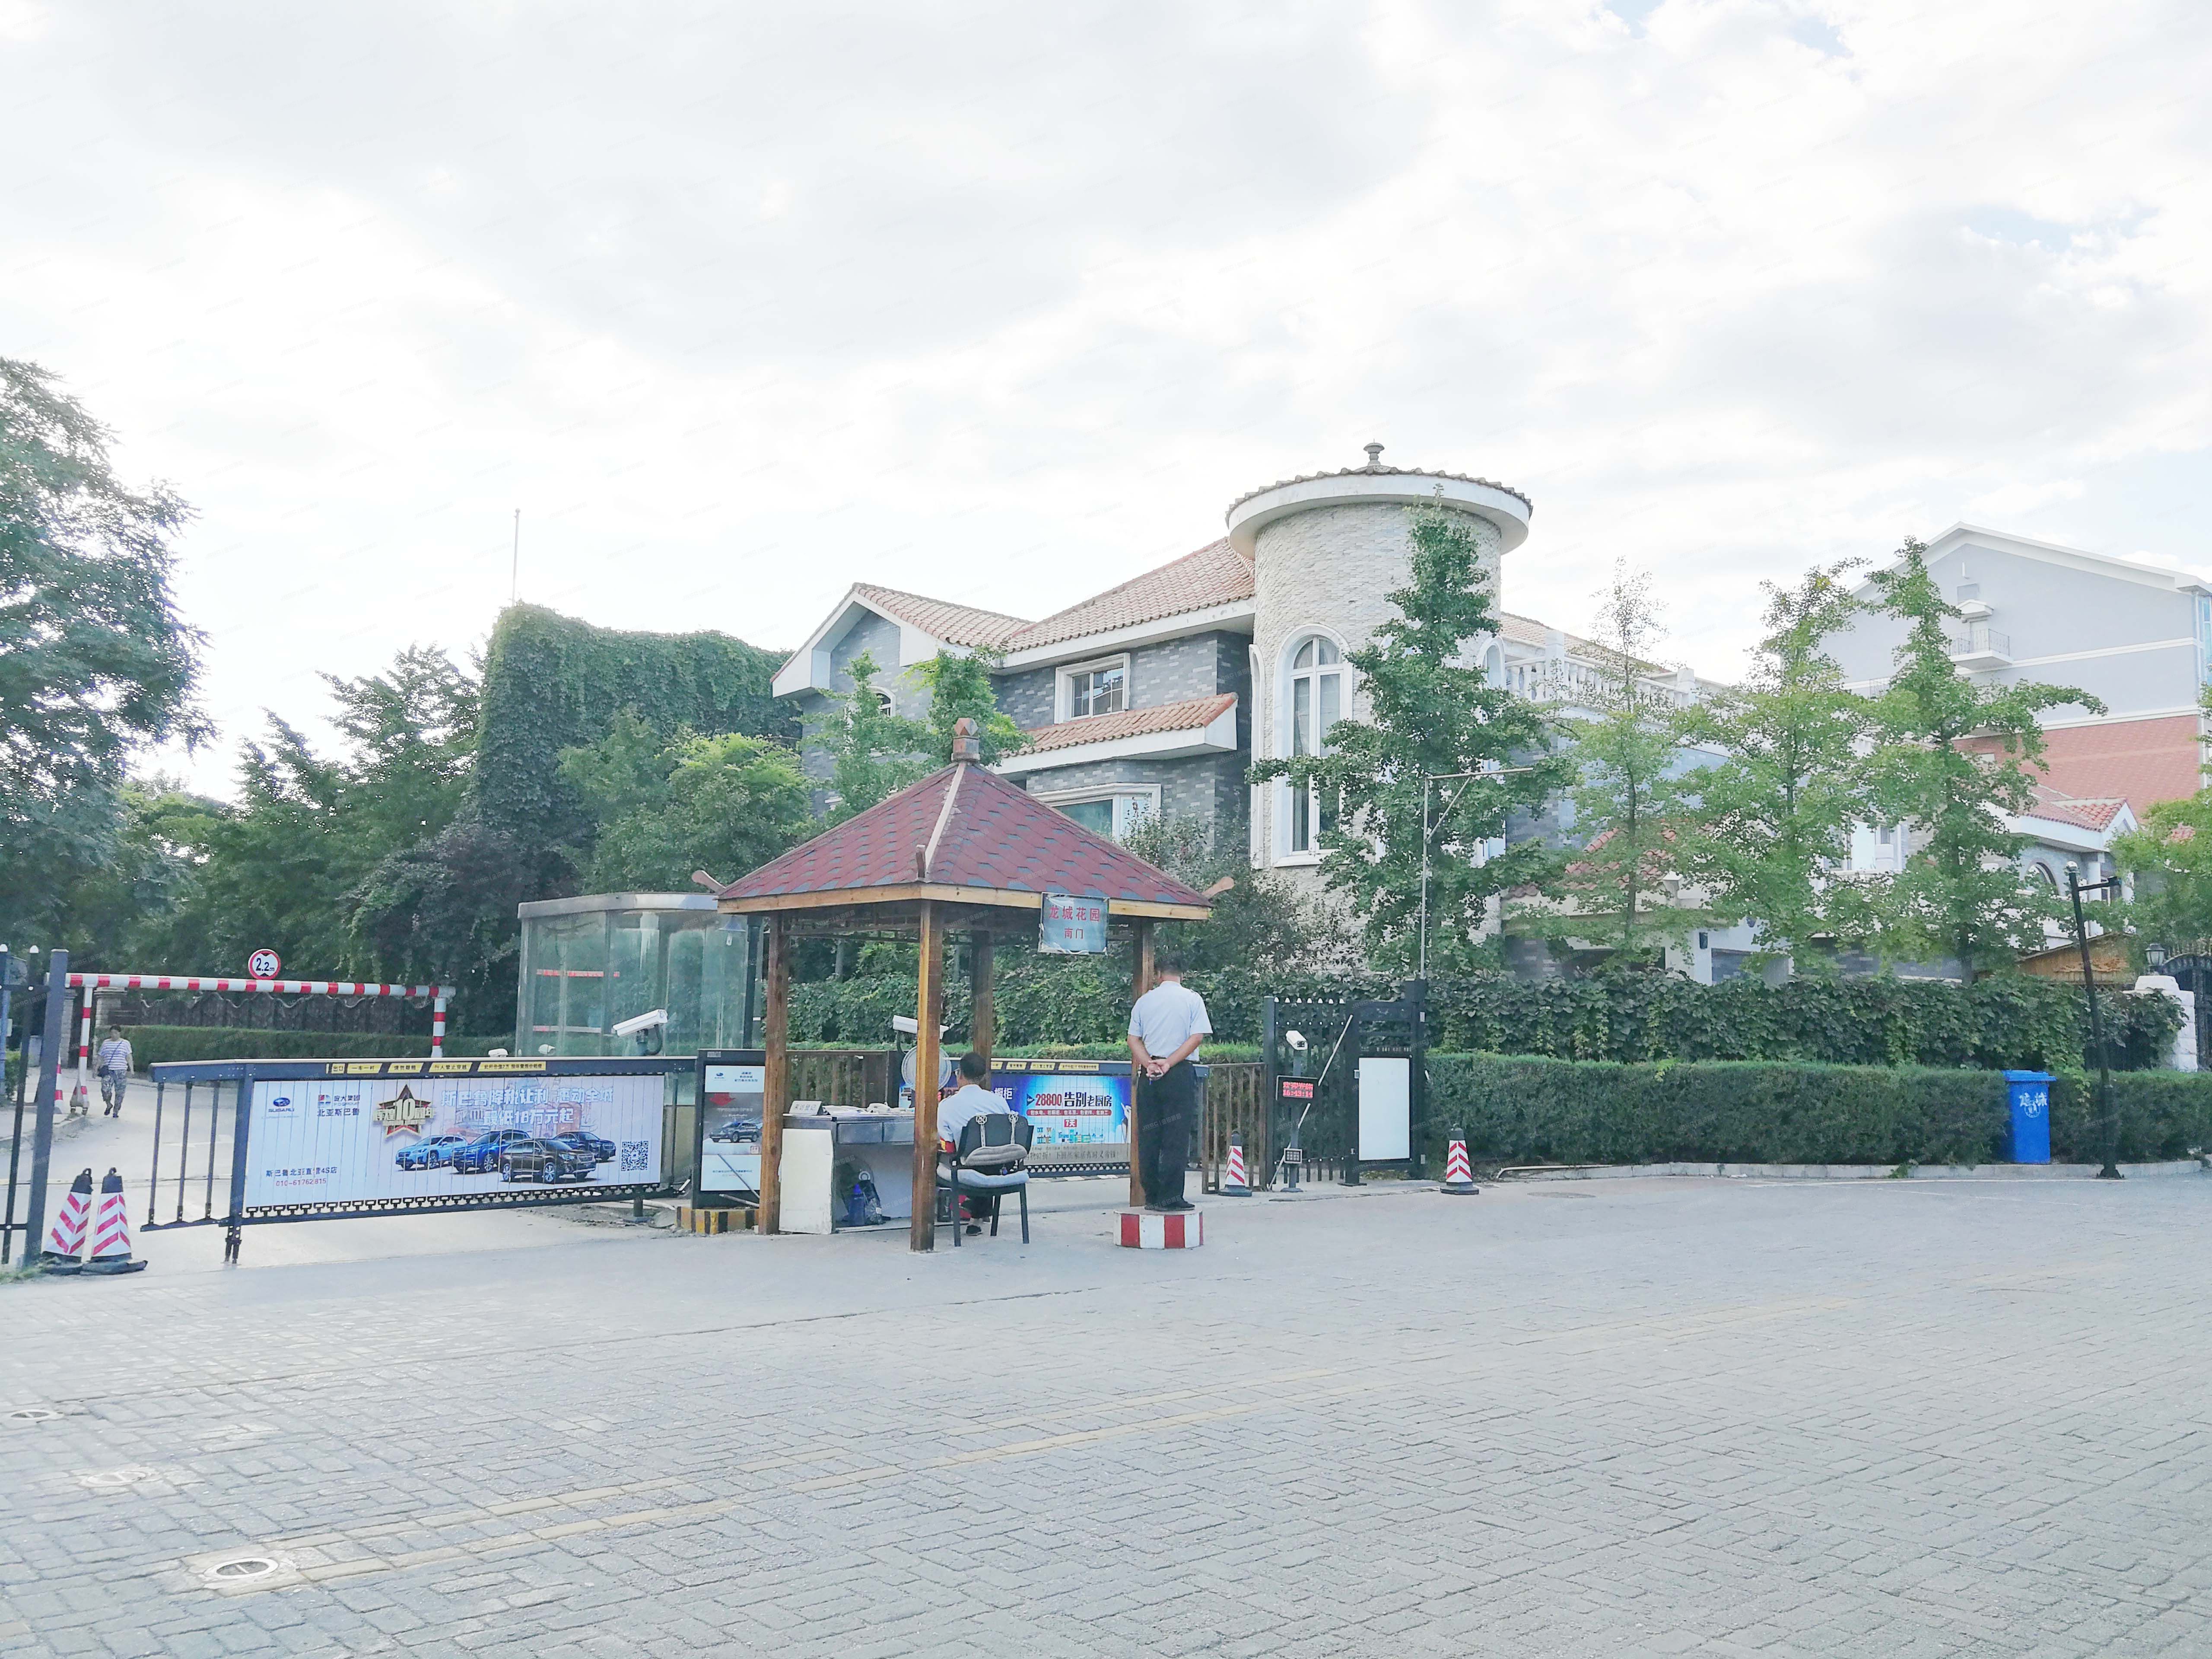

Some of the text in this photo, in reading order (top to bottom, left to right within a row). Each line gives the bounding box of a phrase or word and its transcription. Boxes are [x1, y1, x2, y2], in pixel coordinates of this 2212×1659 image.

[1049, 905, 1100, 921] 龙城花园
[1064, 928, 1083, 939] 南门
[1035, 1094, 1062, 1106] 28800
[1064, 1092, 1112, 1107] 告别老厨房
[317, 1108, 359, 1117] 北亚斯巴鲁
